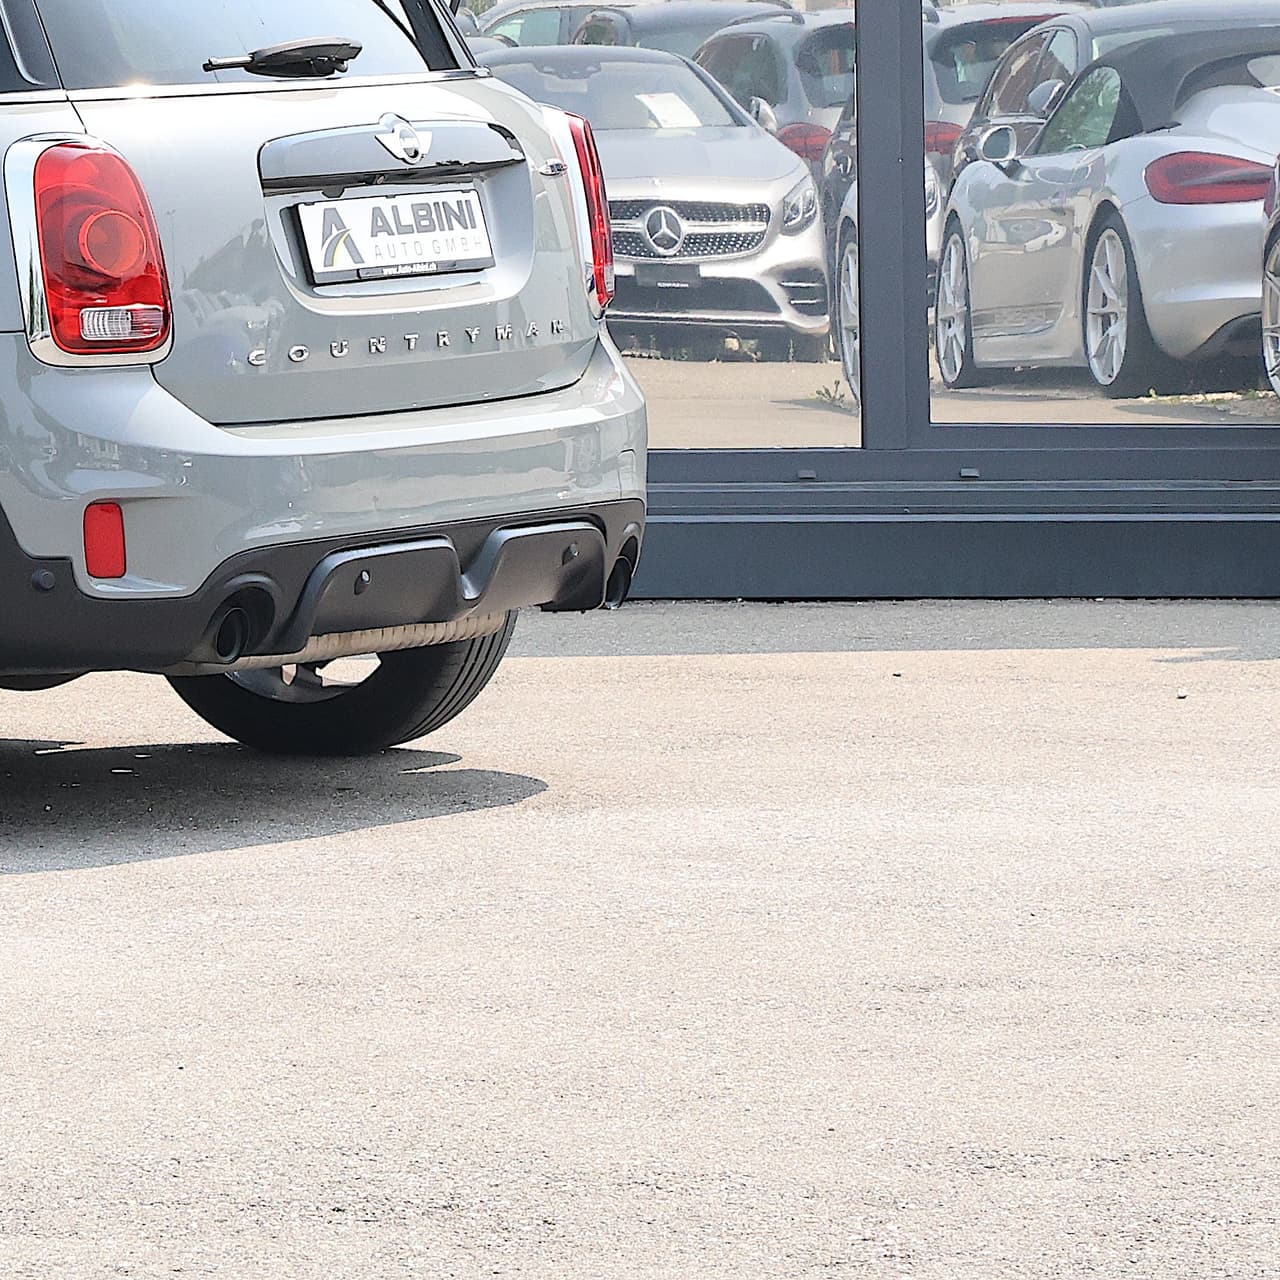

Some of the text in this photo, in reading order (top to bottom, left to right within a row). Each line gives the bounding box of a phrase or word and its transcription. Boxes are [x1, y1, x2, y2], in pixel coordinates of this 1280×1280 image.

[370, 199, 477, 238] ALBINI
[374, 236, 482, 261] AUTO GMBH
[247, 319, 565, 366] COUNTRYMAN
